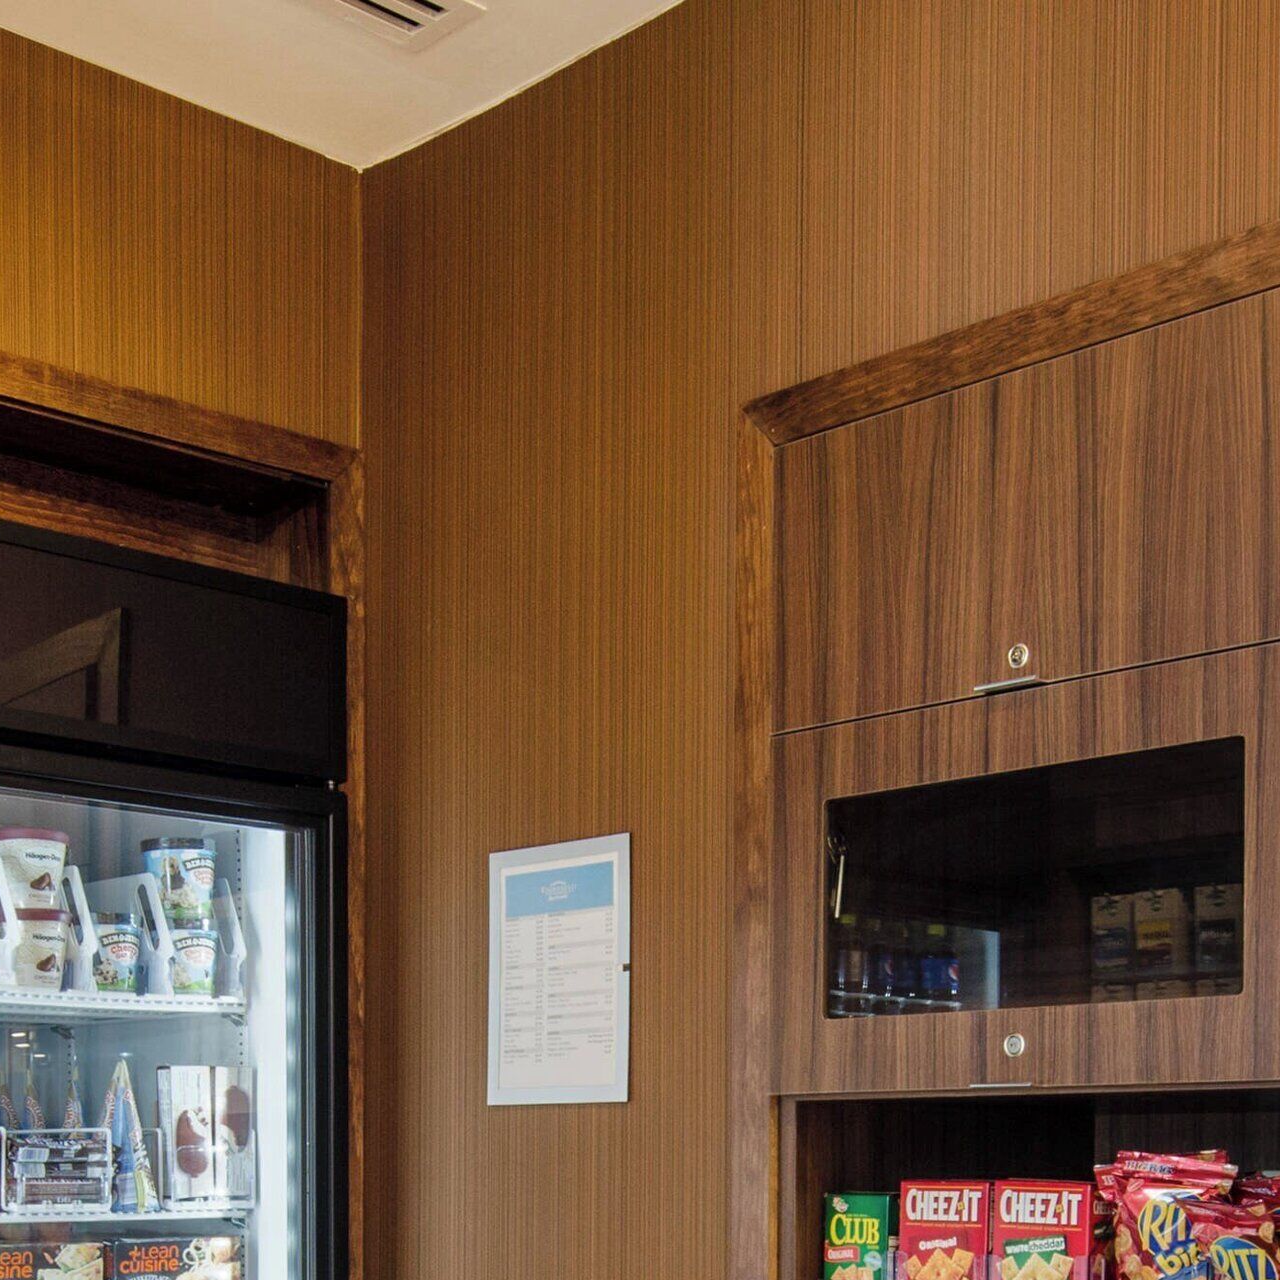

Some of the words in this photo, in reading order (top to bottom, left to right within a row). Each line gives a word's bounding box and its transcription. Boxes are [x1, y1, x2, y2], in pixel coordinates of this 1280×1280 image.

[830, 1214, 880, 1246] CLUB
[141, 1245, 179, 1259] Lean
[119, 1258, 179, 1274] cuisine
